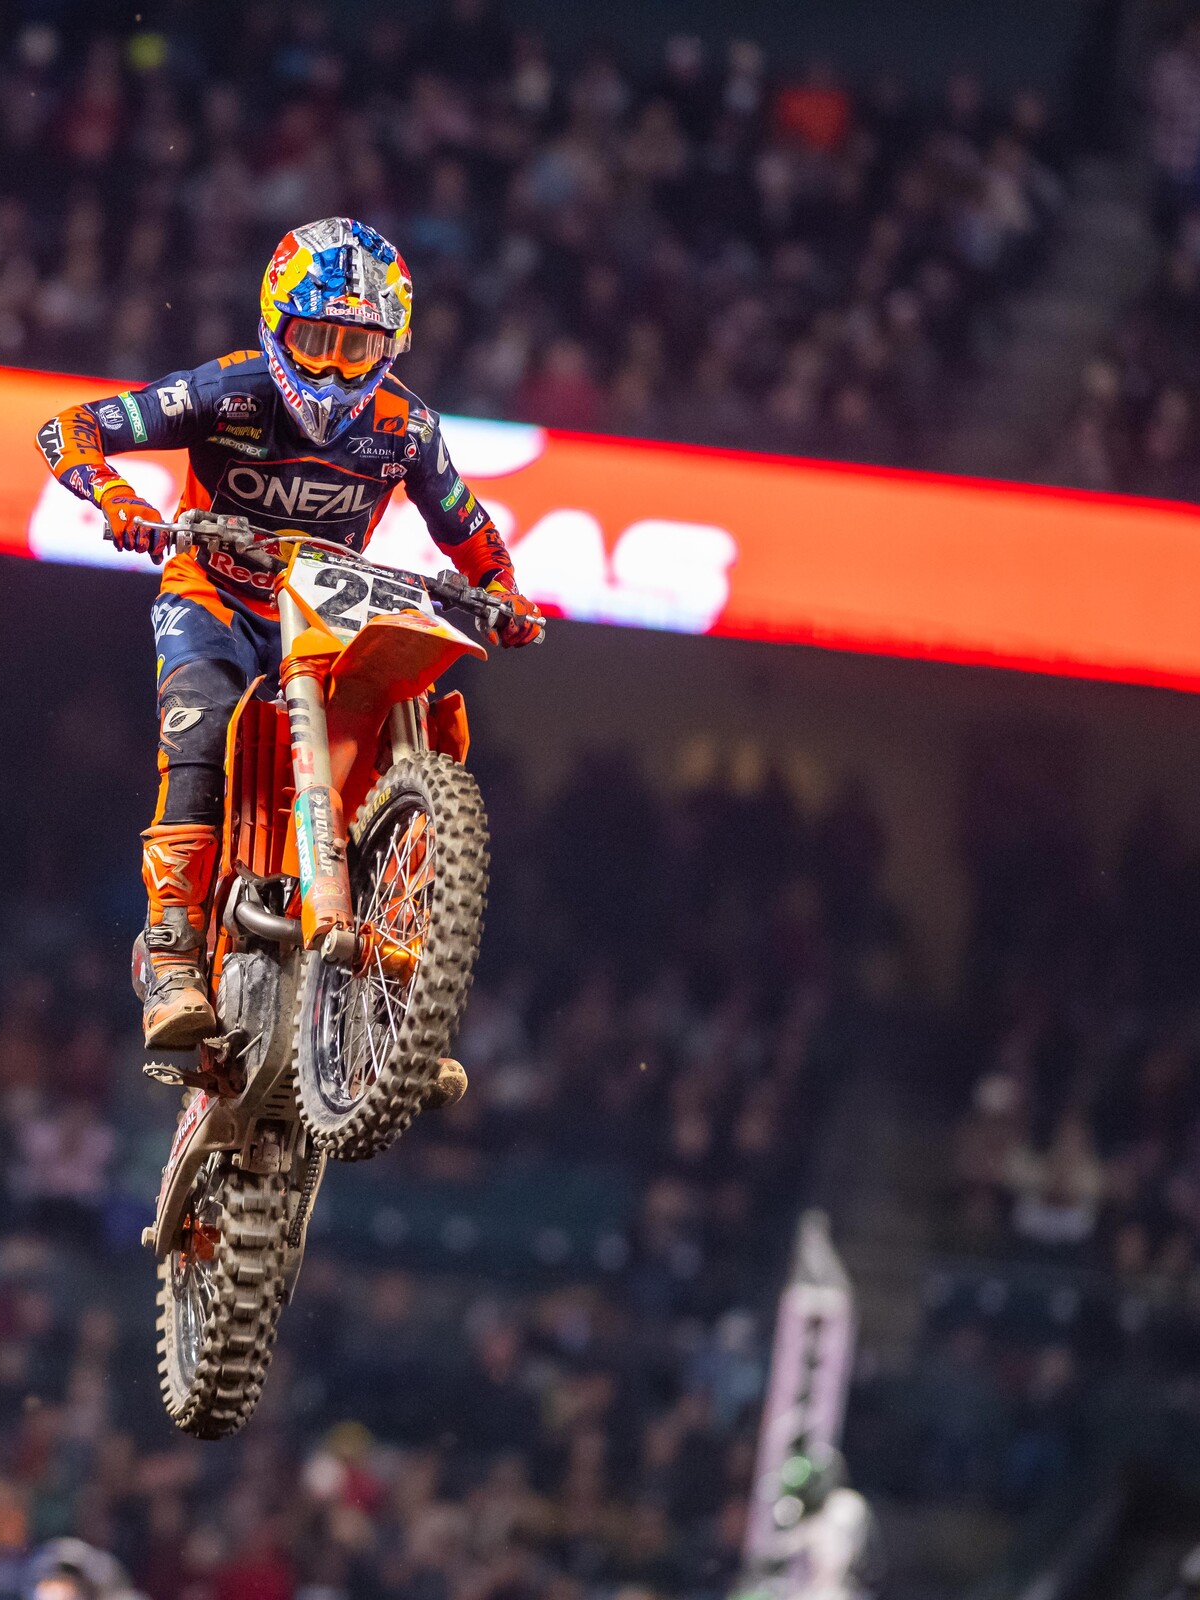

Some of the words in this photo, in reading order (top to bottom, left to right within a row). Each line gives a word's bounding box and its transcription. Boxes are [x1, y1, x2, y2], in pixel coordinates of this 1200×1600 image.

[326, 306, 354, 316] Red
[355, 308, 381, 322] Bull
[123, 397, 145, 438] MOTOREX
[156, 379, 193, 417] 25
[36, 416, 65, 471] KTM
[219, 437, 262, 457] MOTOREX
[208, 551, 276, 590] Red
[314, 568, 422, 631] 25
[296, 824, 314, 888] MOTOREX
[313, 806, 335, 878] DUNLOP
